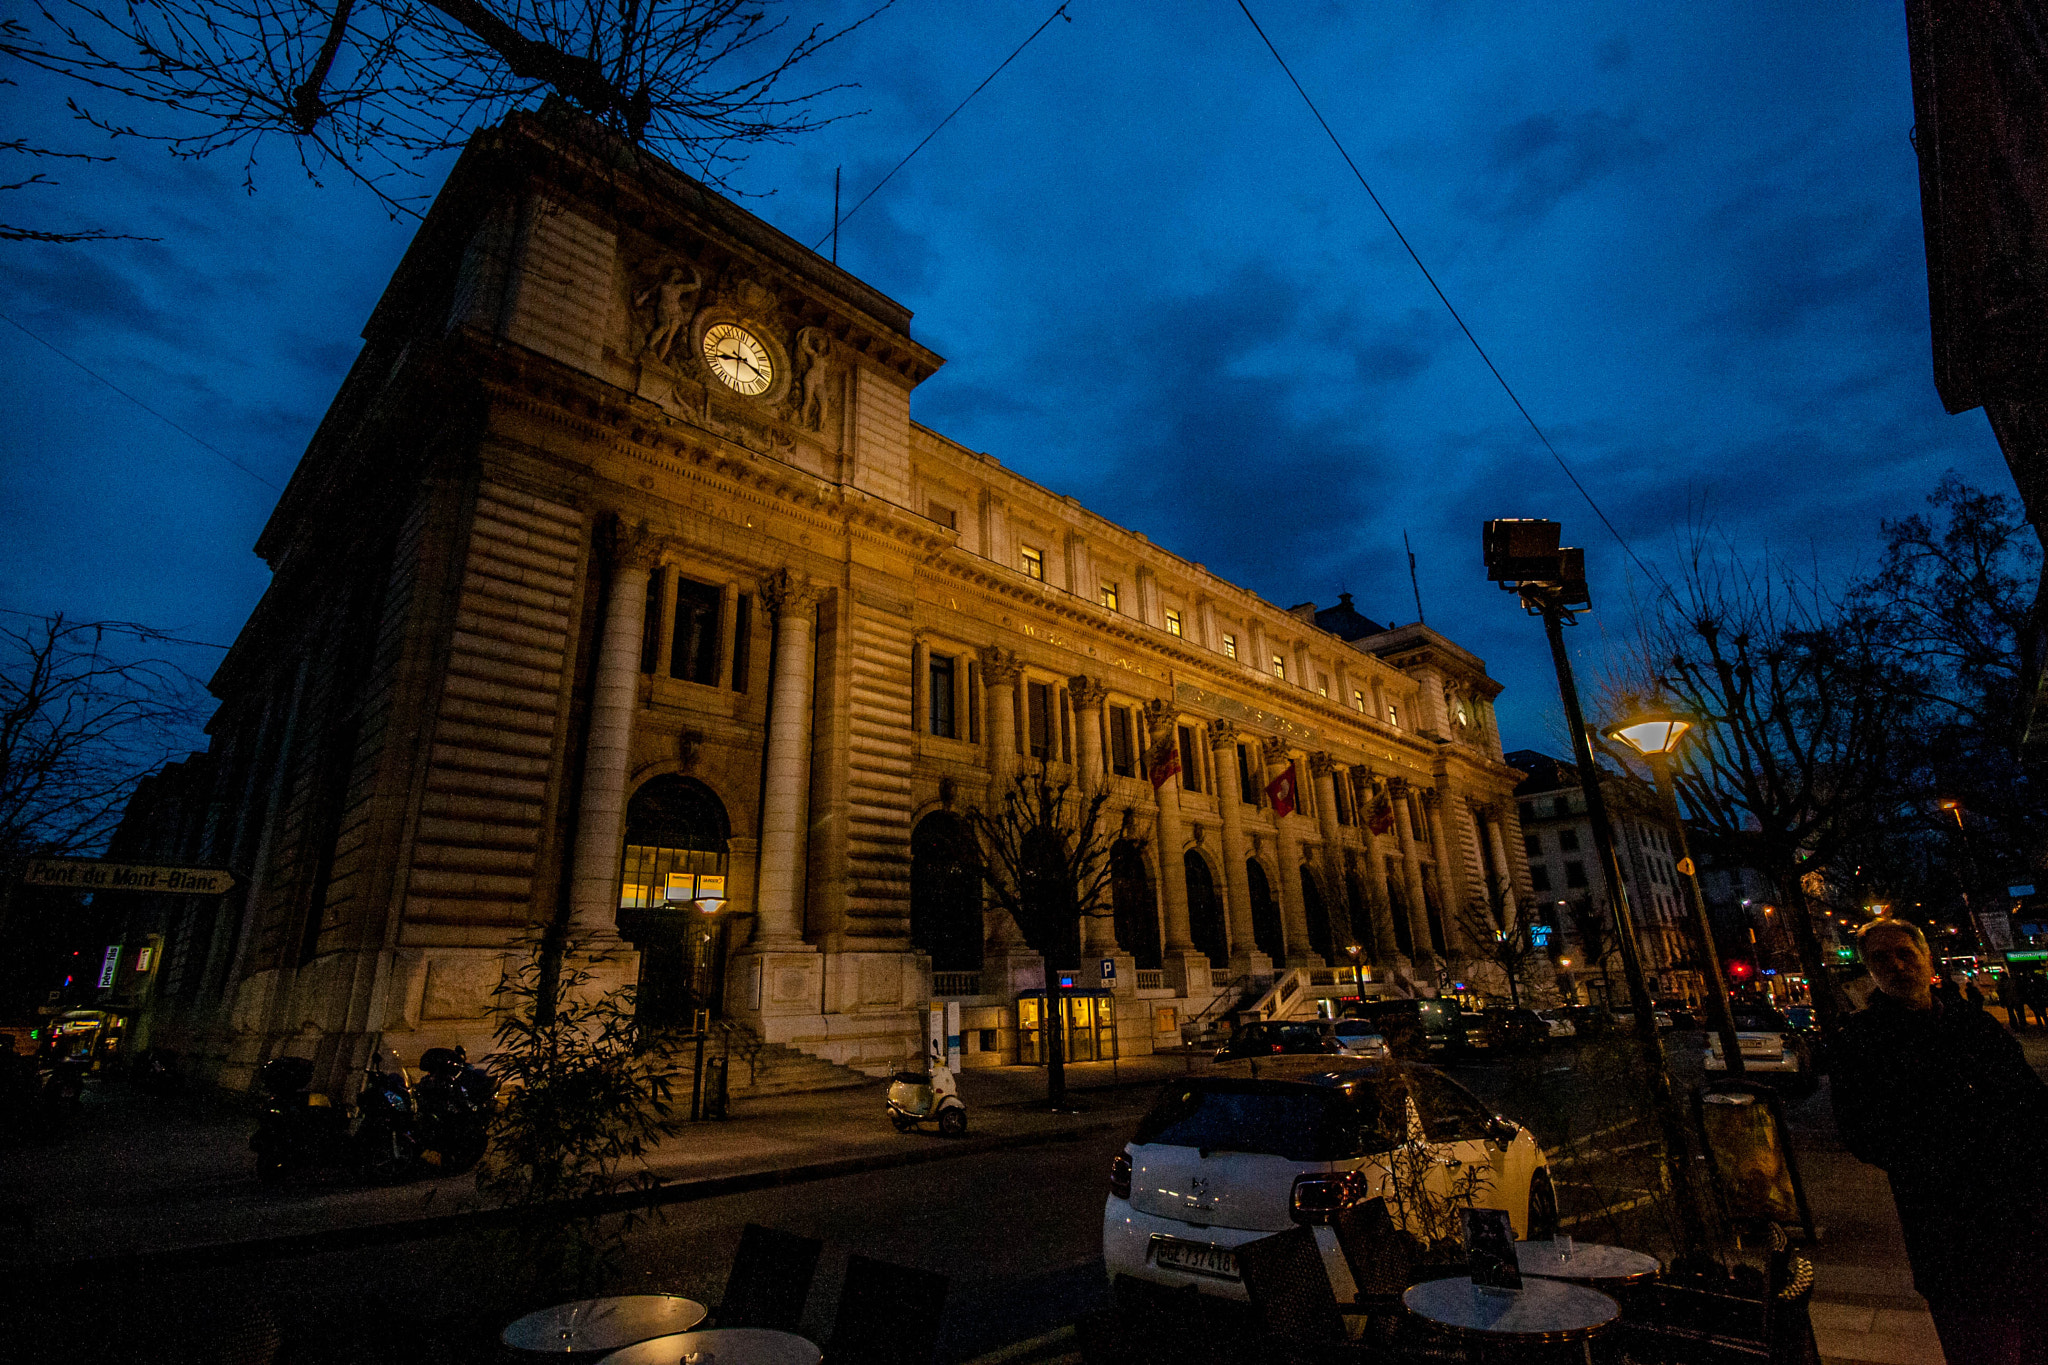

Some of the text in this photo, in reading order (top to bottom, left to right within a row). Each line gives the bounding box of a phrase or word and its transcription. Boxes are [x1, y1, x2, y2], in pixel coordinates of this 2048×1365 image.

[33, 862, 218, 891] Pont du Mont-Blanc
[1104, 962, 1112, 977] P
